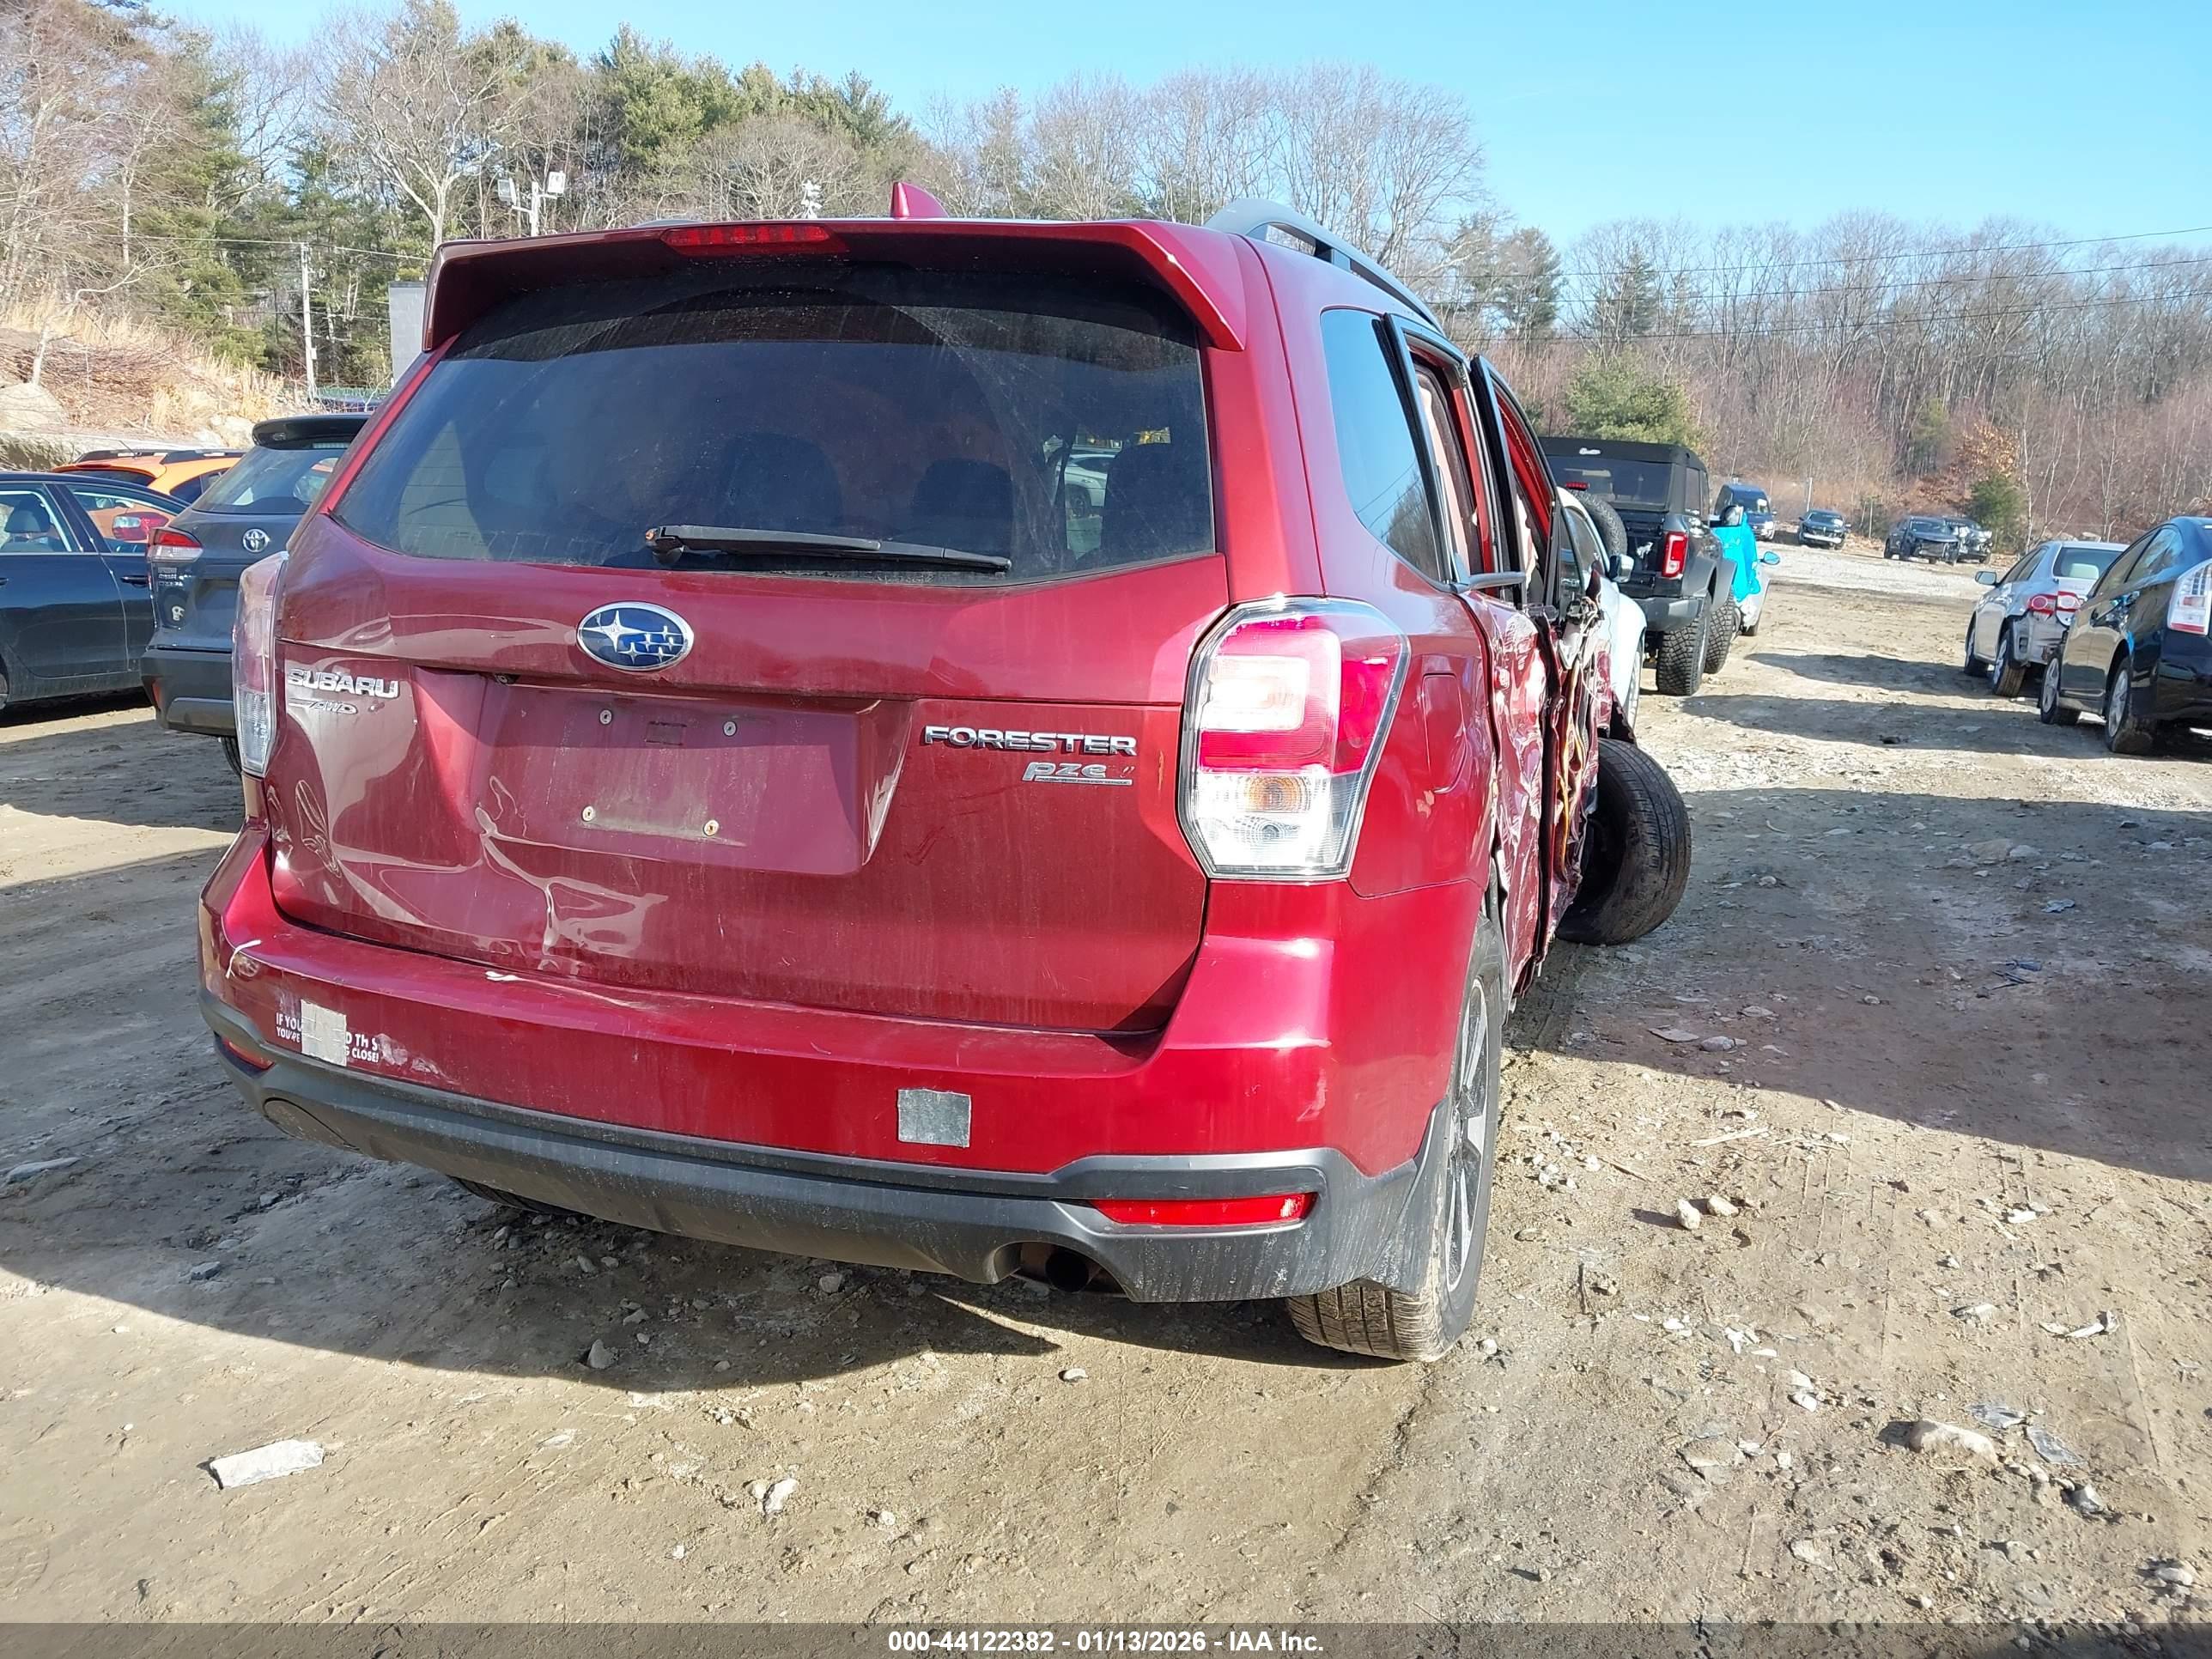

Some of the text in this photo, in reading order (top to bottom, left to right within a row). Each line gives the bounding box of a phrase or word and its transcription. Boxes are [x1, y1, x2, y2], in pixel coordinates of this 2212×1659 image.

[287, 667, 400, 700] SUBARU
[313, 699, 359, 715] AWD
[924, 726, 1138, 757] FORESTER
[276, 1012, 285, 1026] IF
[284, 1015, 305, 1032] YOU
[351, 1047, 380, 1063] CLOSE!
